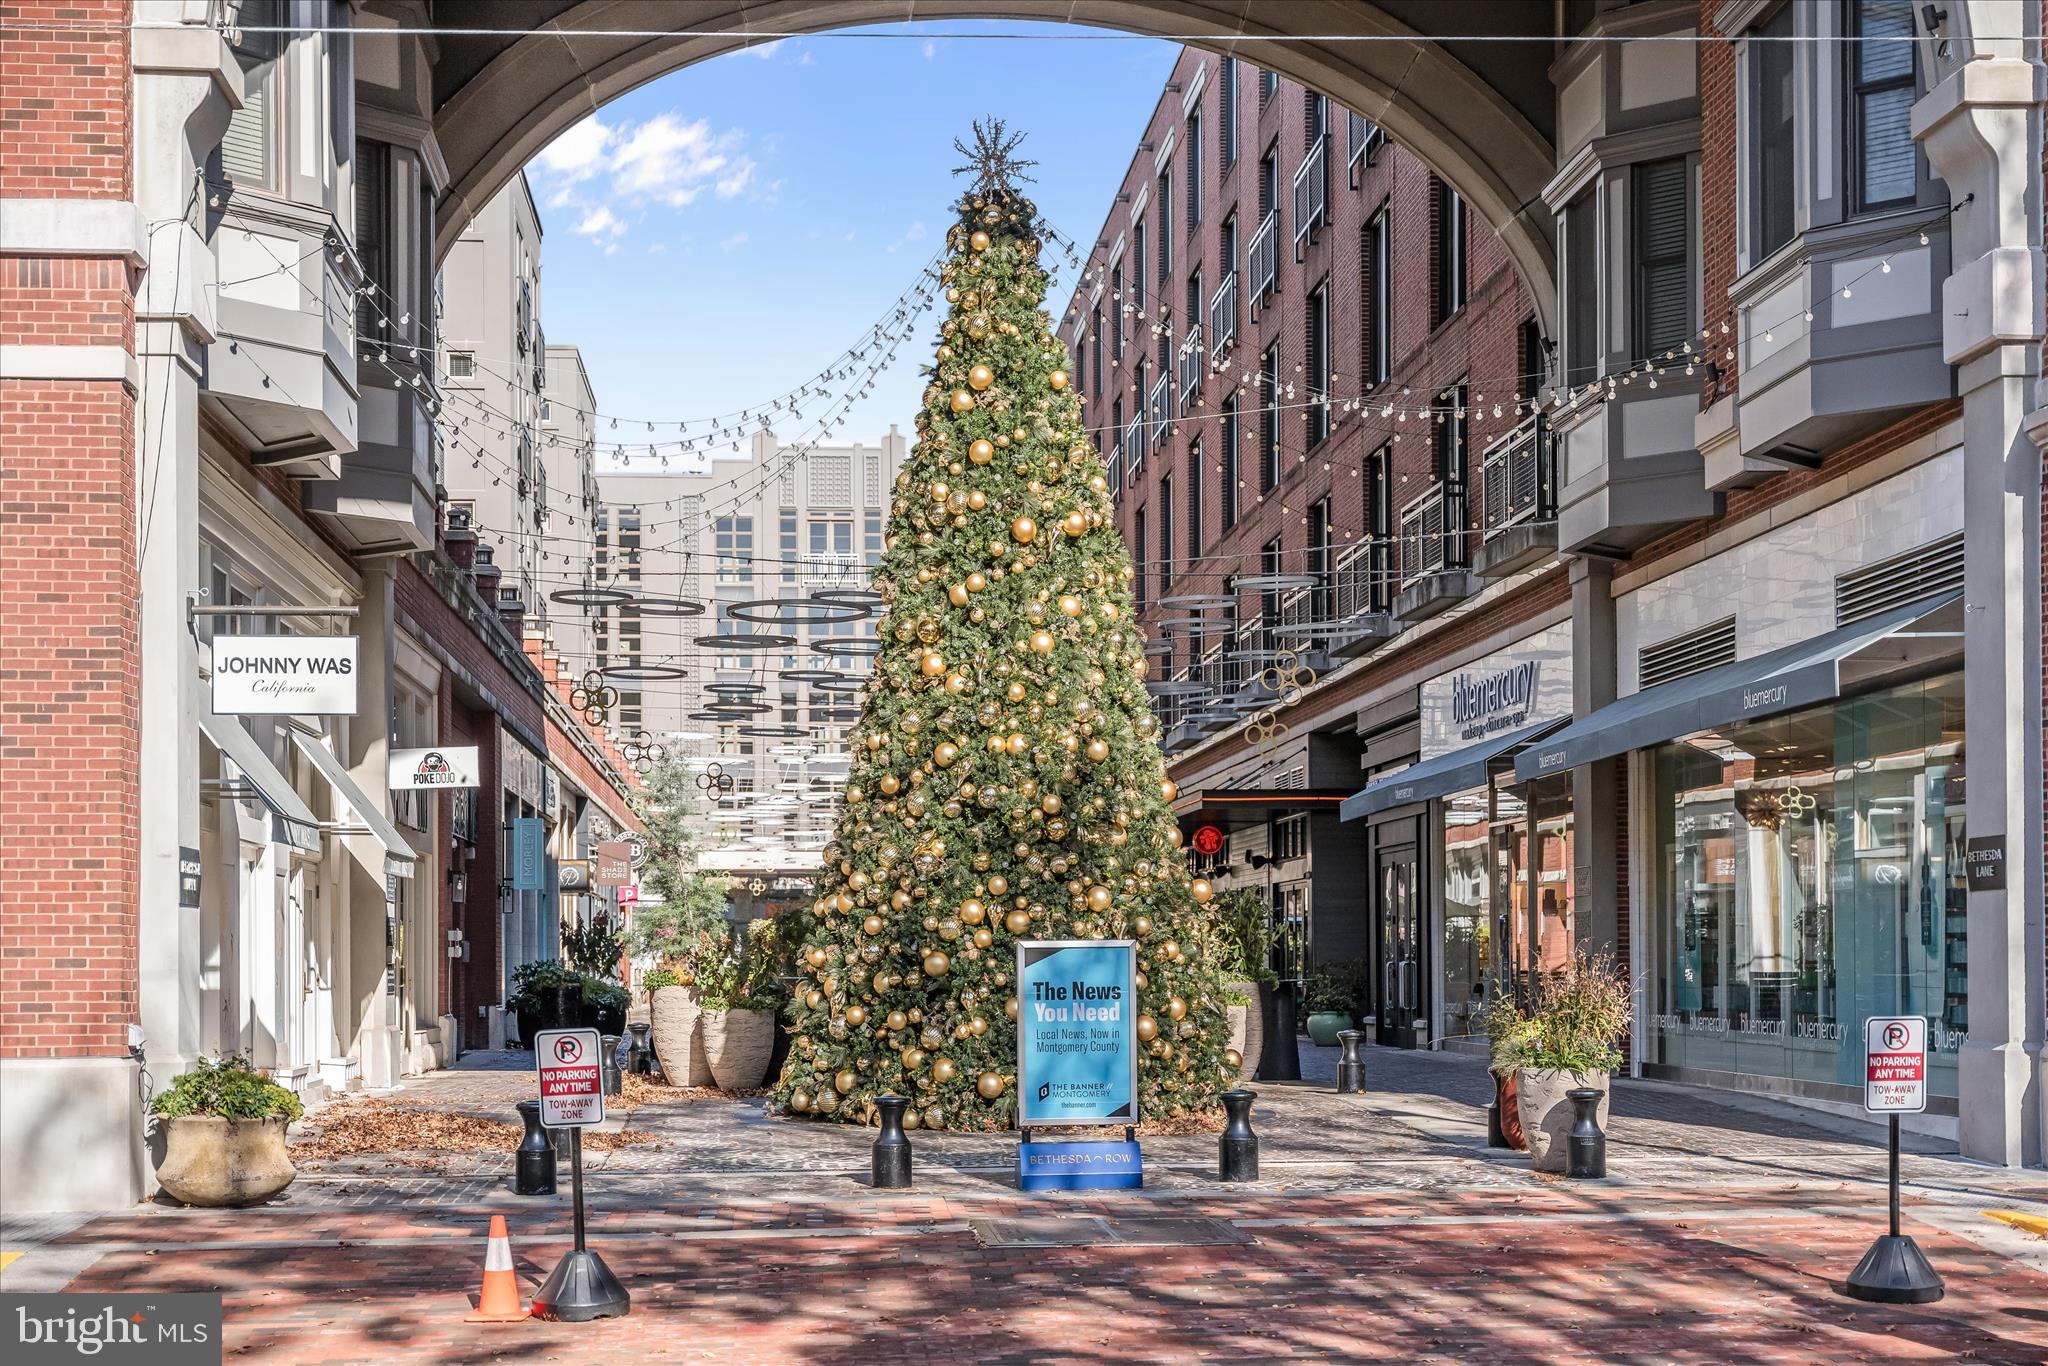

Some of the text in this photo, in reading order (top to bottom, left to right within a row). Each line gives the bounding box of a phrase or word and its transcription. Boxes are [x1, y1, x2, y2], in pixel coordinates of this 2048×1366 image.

[218, 657, 352, 675] JOHNNY WAS
[251, 679, 317, 698] California
[1452, 661, 1534, 724] bluemercury
[1743, 684, 1788, 710] bluemercury
[1538, 750, 1567, 769] bluemercury
[413, 772, 456, 785] POKE DOJO
[523, 831, 534, 877] MORLEY
[1968, 848, 2003, 863] BETHESDA
[1975, 865, 1995, 878] LANE
[1033, 981, 1122, 1001] The News
[1034, 1001, 1120, 1022] You Need
[1689, 1009, 1731, 1038] bluemercury
[1740, 1011, 1786, 1041] bluemercury
[1036, 1028, 1120, 1041] Local News, Now in
[1797, 1014, 1849, 1047] bluemercury
[1036, 1040, 1120, 1055] Montgomery County
[1870, 1056, 1921, 1067] NO PARKING
[542, 1069, 597, 1082] NO PARKING
[1875, 1069, 1916, 1079] ANY TIME
[549, 1081, 592, 1094] ANY TIME
[1052, 1083, 1105, 1091] THE BANNER
[1873, 1085, 1916, 1095] TOW-AWAY
[1052, 1090, 1111, 1099] MONTGOMERY
[1884, 1096, 1905, 1105] ZONE
[549, 1098, 594, 1110] TOW-AWAY
[1061, 1101, 1097, 1109] thebanner.com
[561, 1110, 583, 1120] ZONE
[1030, 1153, 1132, 1165] BETHESDA ROW
